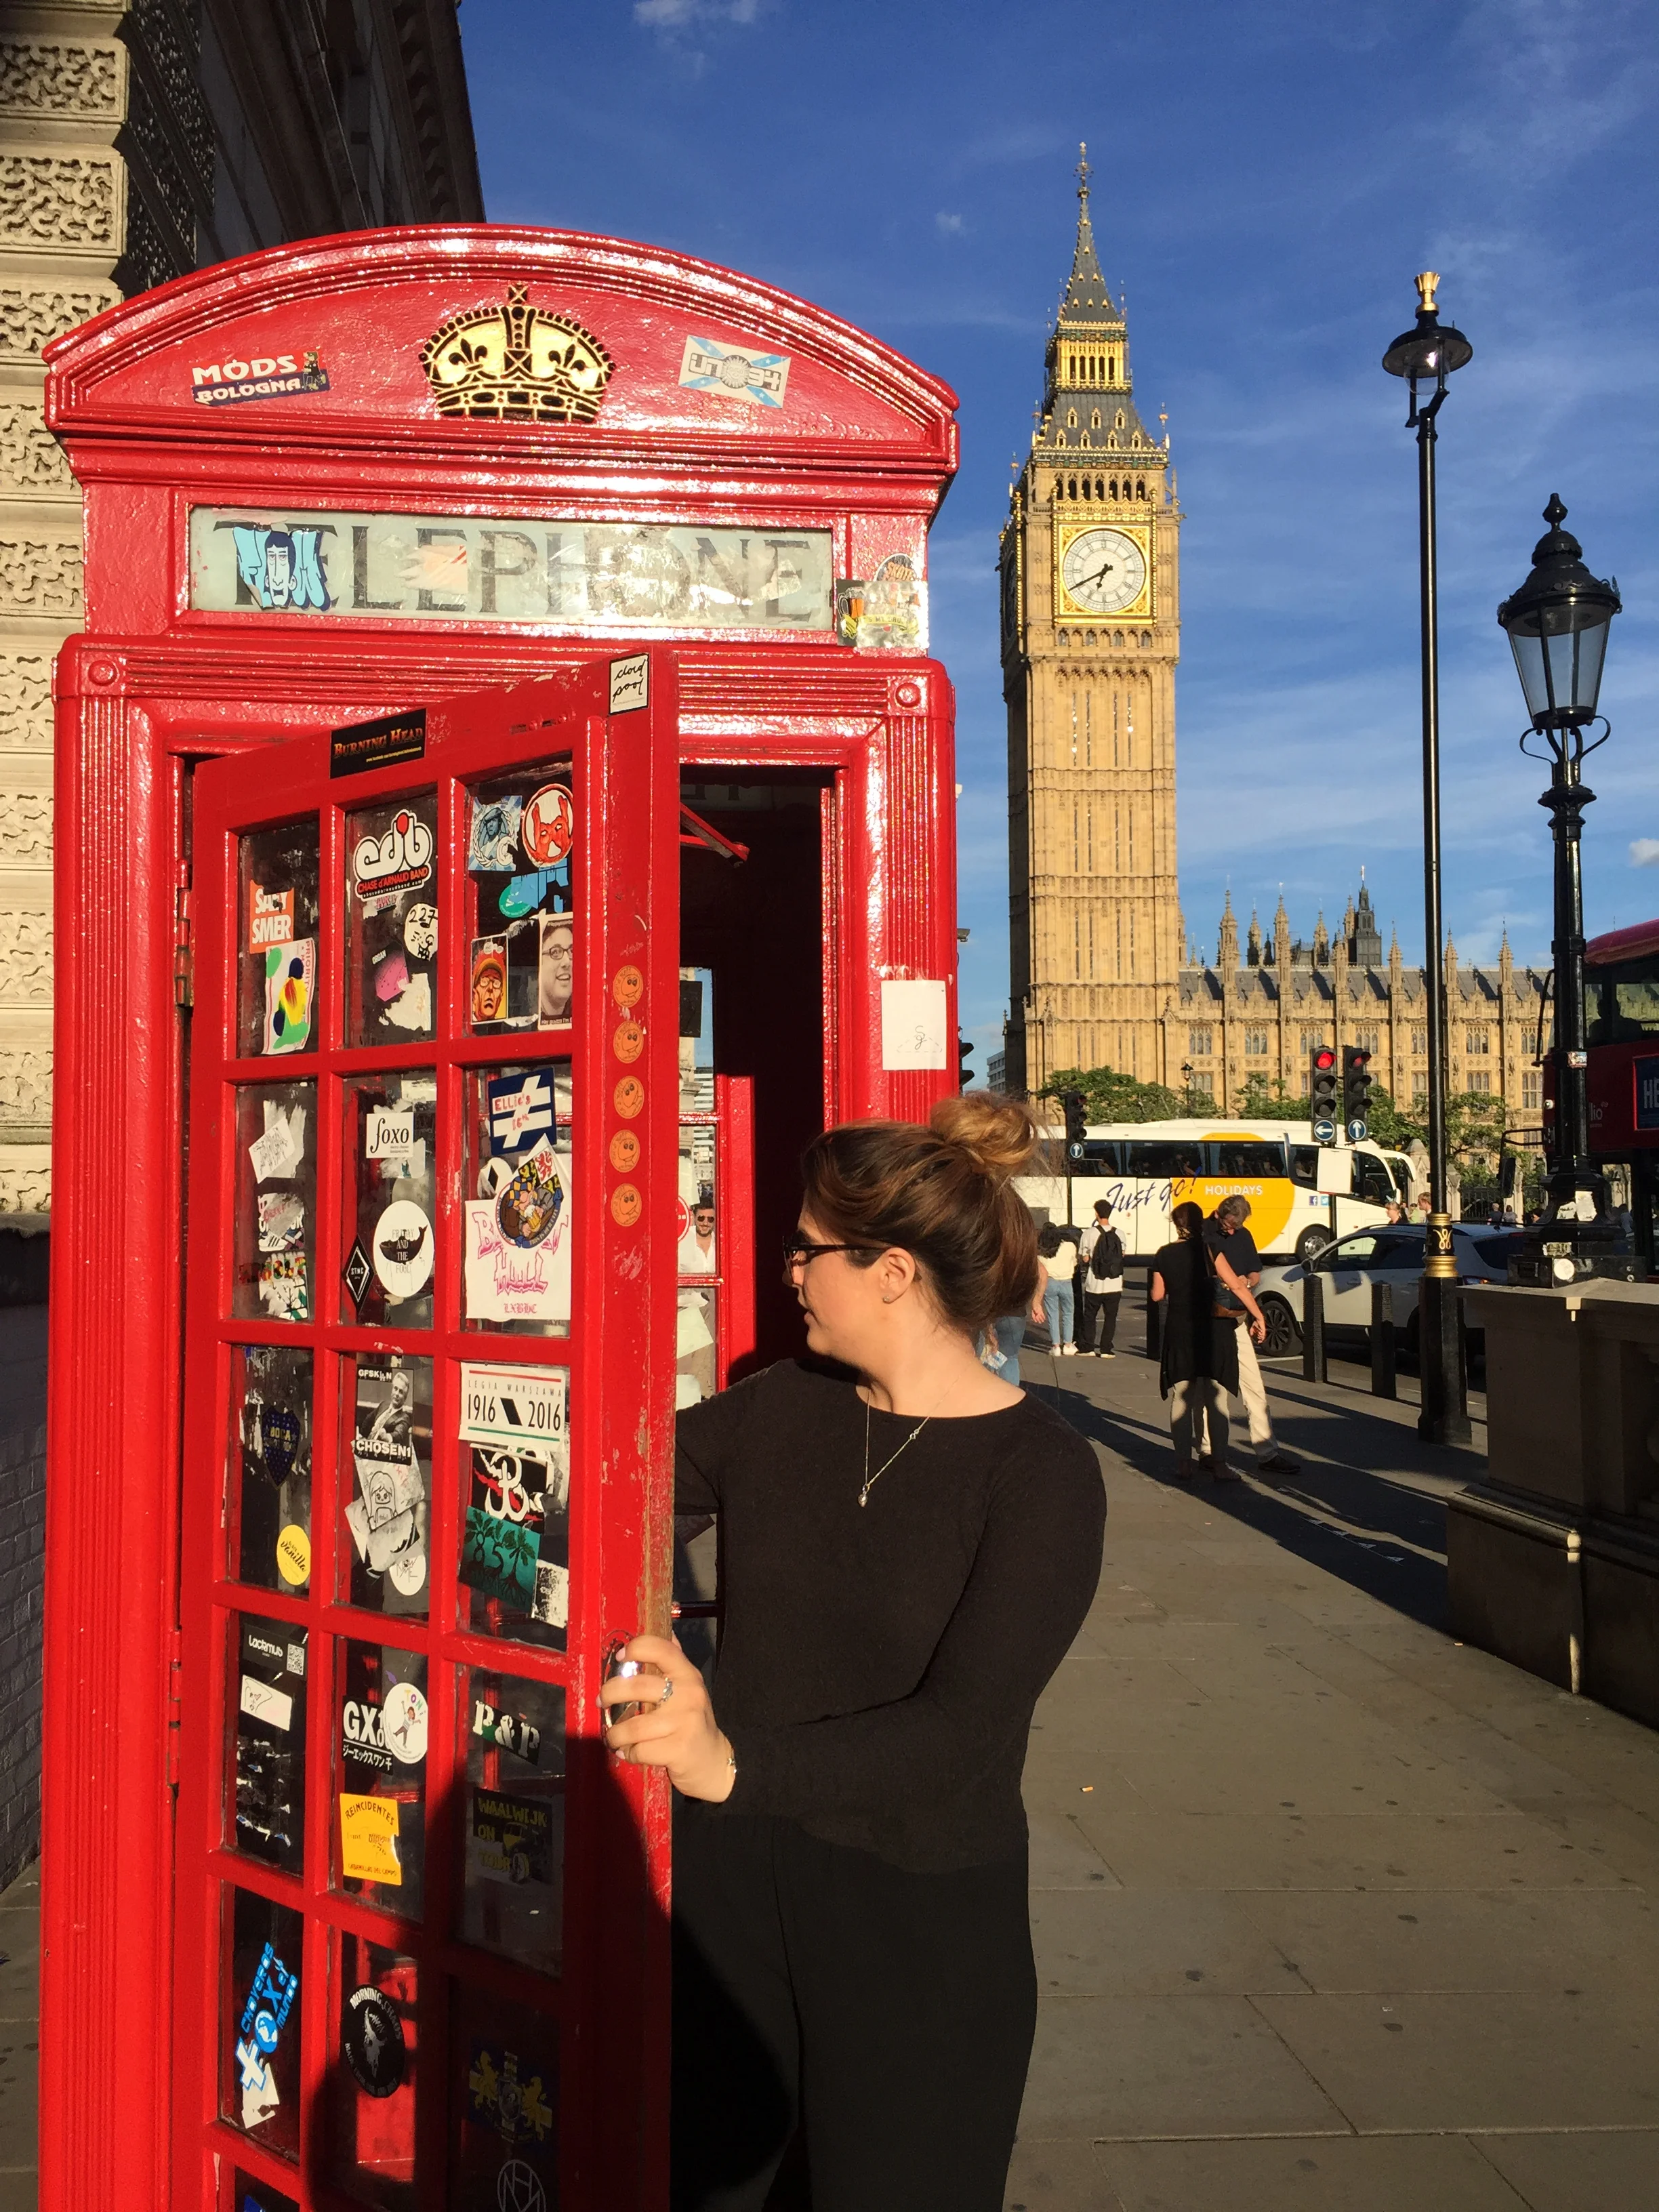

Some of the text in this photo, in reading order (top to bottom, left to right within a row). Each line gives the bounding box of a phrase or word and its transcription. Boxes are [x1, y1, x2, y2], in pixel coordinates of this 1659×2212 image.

[192, 354, 298, 386] MODS
[196, 377, 304, 405] BOLOGNA
[213, 520, 813, 621] TLEPHNE
[410, 867, 428, 880] BAND
[1205, 1185, 1263, 1195] HOLIDAYS
[396, 1240, 409, 1250] AND
[396, 1251, 409, 1261] THE
[468, 1379, 562, 1397] LEGIA WARSZAWA
[468, 1393, 561, 1431] 1916 2016
[345, 1801, 395, 1826] REINCIDENTES
[349, 1987, 383, 2010] MORNING
